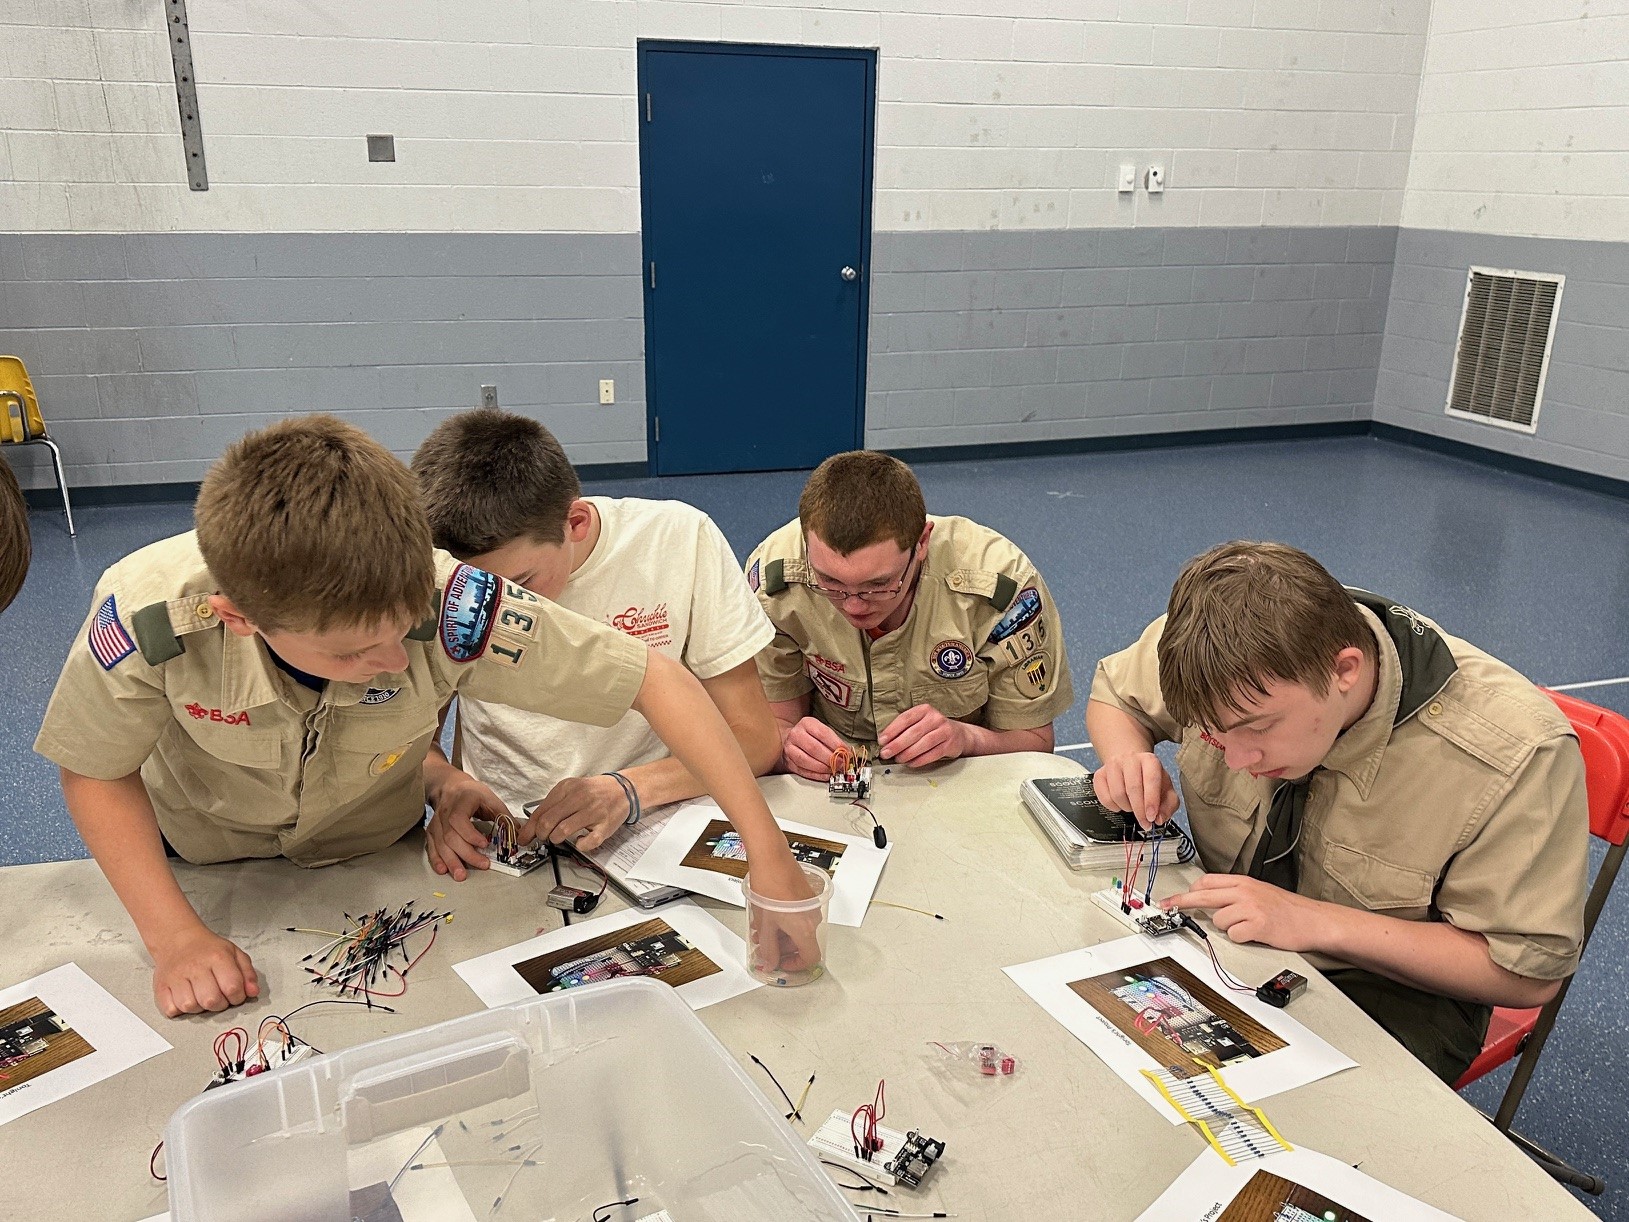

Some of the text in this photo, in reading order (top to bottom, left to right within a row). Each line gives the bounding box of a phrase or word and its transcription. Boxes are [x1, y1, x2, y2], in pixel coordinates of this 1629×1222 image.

[447, 600, 459, 612] OF
[446, 614, 459, 642] SPIRIT
[637, 618, 667, 628] SANDWICH
[825, 660, 845, 673] BSA
[1203, 1201, 1222, 1220] Project
